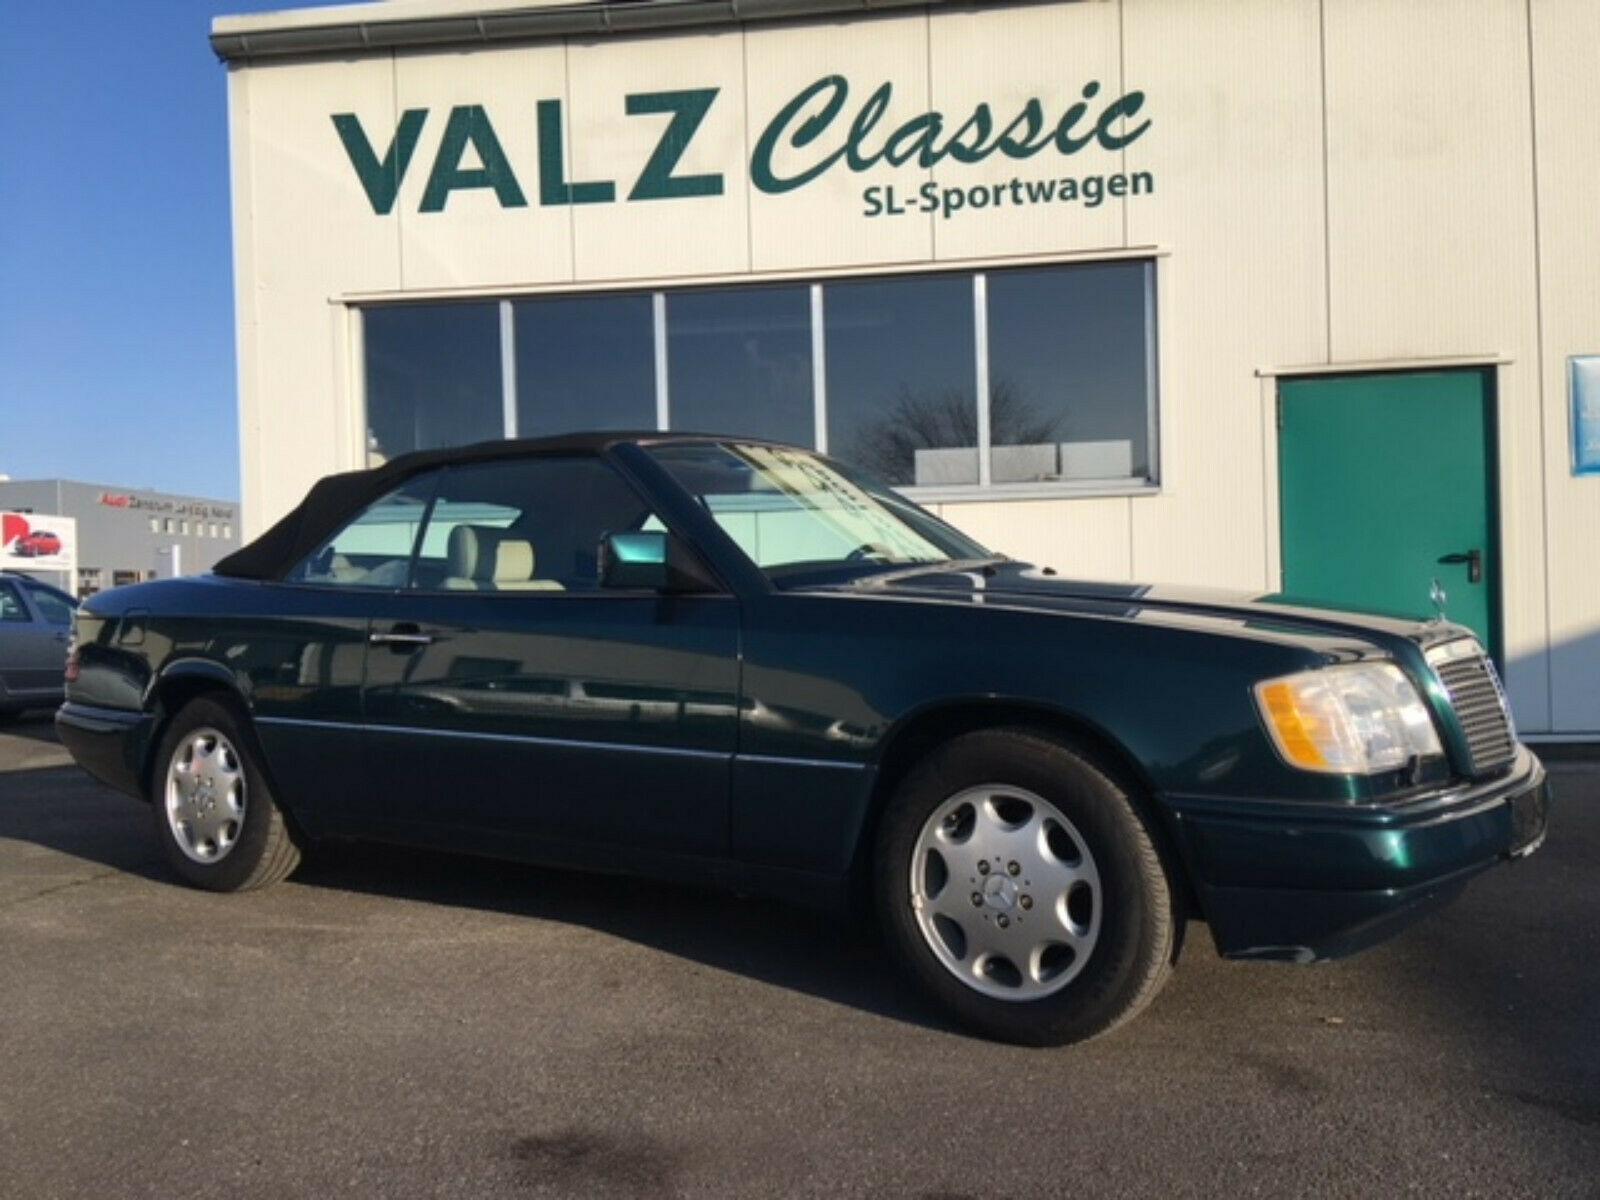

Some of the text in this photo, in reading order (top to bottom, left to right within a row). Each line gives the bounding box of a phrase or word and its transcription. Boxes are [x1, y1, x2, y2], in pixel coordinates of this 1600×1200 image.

[331, 74, 1152, 216] VALZ Classic
[863, 171, 1153, 219] SL-Sportwagen
[100, 492, 128, 508] Audi
